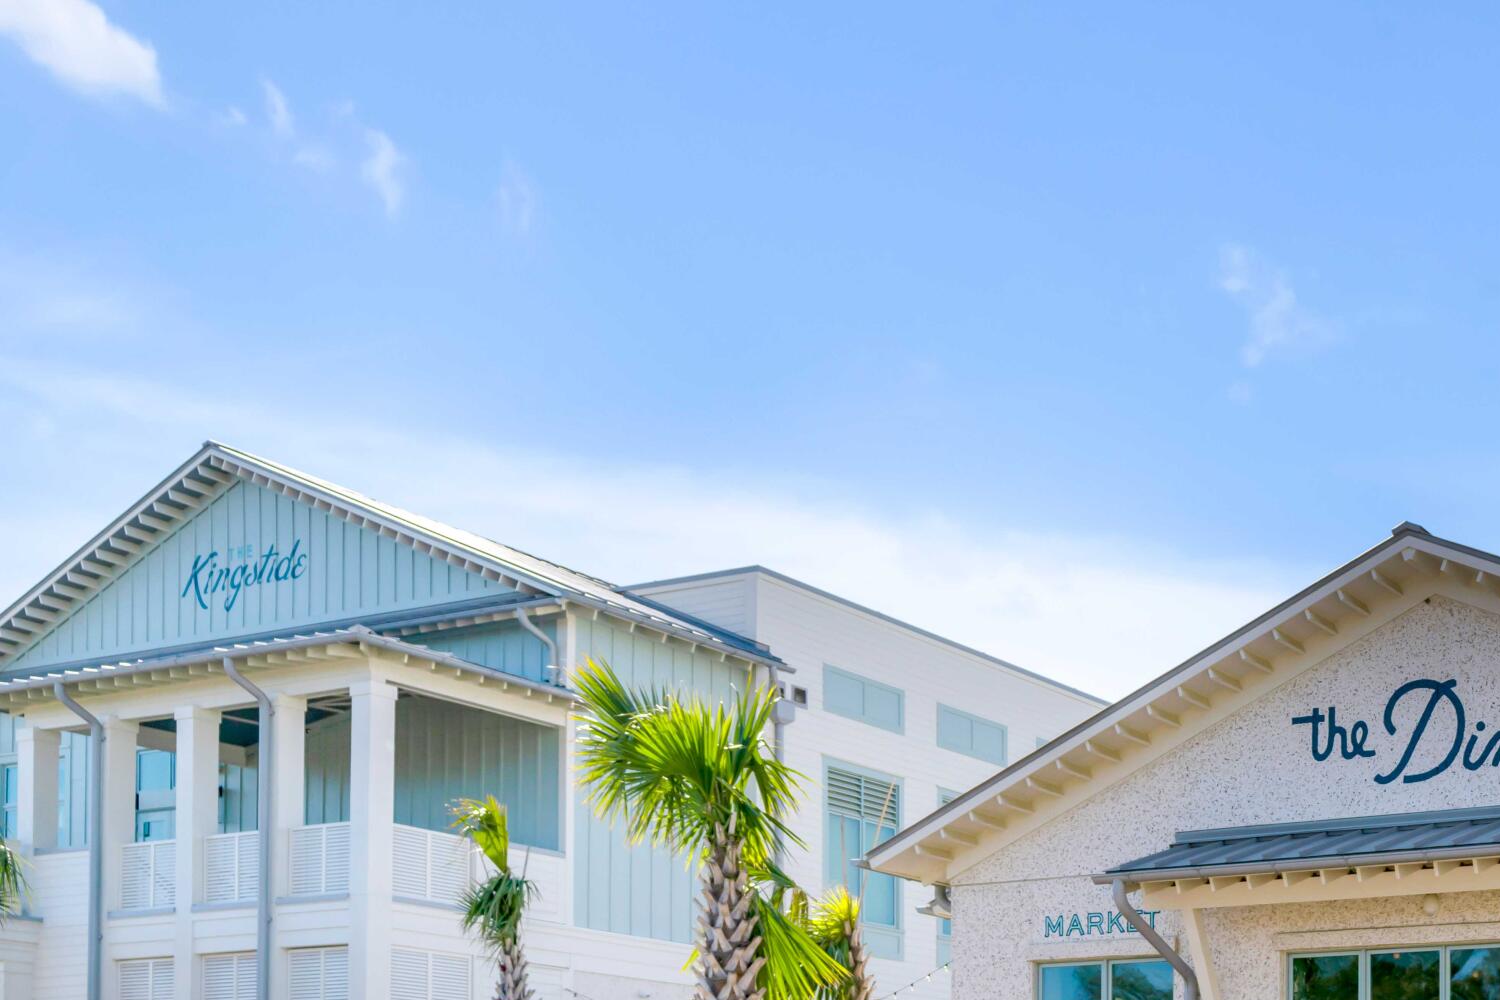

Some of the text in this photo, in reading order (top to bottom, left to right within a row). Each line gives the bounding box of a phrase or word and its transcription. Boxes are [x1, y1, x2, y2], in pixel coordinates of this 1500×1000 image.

[182, 539, 307, 612] Kingstide
[227, 544, 253, 560] THE
[1292, 706, 1376, 762] the
